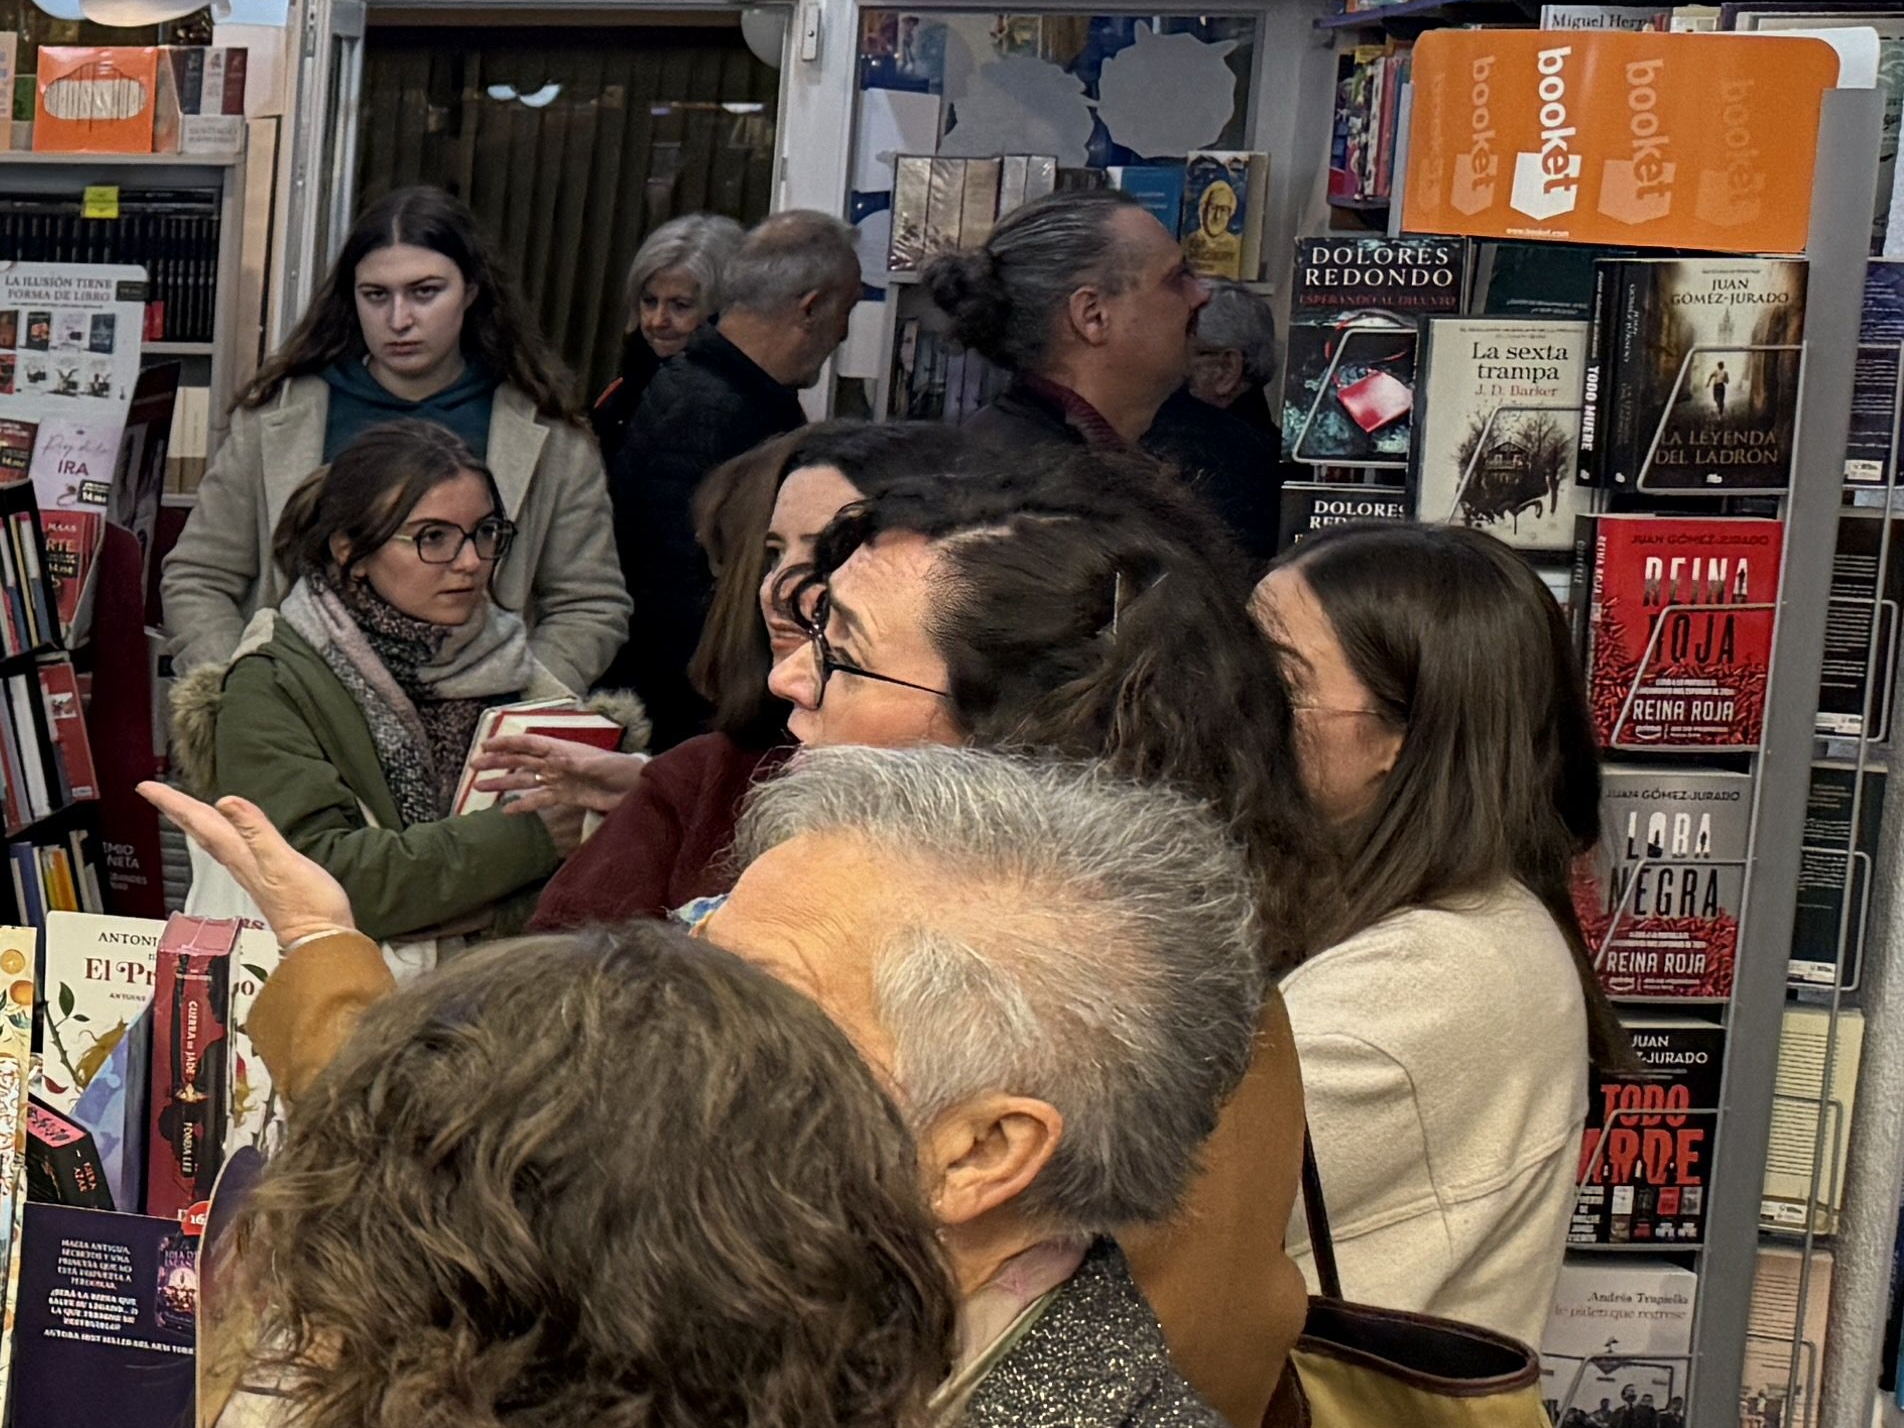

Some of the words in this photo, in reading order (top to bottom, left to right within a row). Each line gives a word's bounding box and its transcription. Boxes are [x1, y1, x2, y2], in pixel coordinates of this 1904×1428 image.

[1552, 13, 1603, 29] Miguel
[1472, 56, 1496, 192] booket
[1537, 46, 1577, 195] booket
[1626, 58, 1670, 200] booket
[1312, 246, 1449, 266] DOLORES
[5, 275, 20, 287] LA
[22, 274, 73, 289] ILUSIÓN
[77, 277, 112, 289] TIENE
[1304, 268, 1454, 288] REDONDO
[1711, 278, 1749, 291] JUAN
[8, 289, 47, 302] FORMA
[49, 289, 64, 301] DE
[66, 289, 111, 302] LIBRO
[1299, 293, 1378, 307] ESPERANDO
[1398, 295, 1456, 308] DILUVIO
[1671, 289, 1789, 306] GÓMEZ-JURADO
[1472, 341, 1499, 360] La
[1505, 344, 1568, 361] sexta
[1477, 363, 1560, 384] trampa
[1474, 384, 1486, 397] J.
[1490, 386, 1506, 397] D.
[1510, 384, 1559, 398] Barker
[1584, 366, 1599, 403] TODO
[1580, 405, 1597, 452] MUERE
[1660, 430, 1682, 445] LA
[1689, 429, 1777, 447] LEYENDA
[1654, 448, 1688, 465] DEL
[1694, 445, 1779, 465] LADRÓN
[57, 460, 89, 476] IRA
[1632, 533, 1664, 545] JUAN
[1643, 556, 1749, 608] REINA
[1648, 613, 1736, 665] ROJA
[1633, 699, 1685, 722] REINA
[1690, 700, 1734, 722] ROJA
[1605, 789, 1639, 799] JUAN
[1626, 811, 1712, 860] LOBA
[1608, 866, 1719, 918] NEGRA
[84, 957, 111, 982] El
[1606, 951, 1658, 973] REINA
[1664, 952, 1707, 975] ROJA
[1631, 1034, 1669, 1049] JUAN
[185, 1049, 197, 1074] JADE
[1600, 1083, 1690, 1128] TODO
[183, 1121, 194, 1156] FONDA
[1576, 1128, 1705, 1185] ARDE
[61, 1248, 102, 1260] SECRETOS
[110, 1254, 130, 1264] UNA
[62, 1239, 90, 1249] MAGIA
[92, 1242, 131, 1254] ANTIGUA,
[57, 1266, 78, 1276] ESTÁ
[58, 1257, 98, 1269] PRINCESA
[100, 1262, 117, 1272] QUE
[119, 1264, 132, 1273] NO
[78, 1291, 89, 1300] LA
[91, 1292, 116, 1304] REINA
[118, 1296, 137, 1306] QUE
[51, 1306, 62, 1315] LA
[63, 1307, 82, 1318] QUE
[1608, 1308, 1635, 1321] que
[44, 1329, 80, 1340] AUTORA
